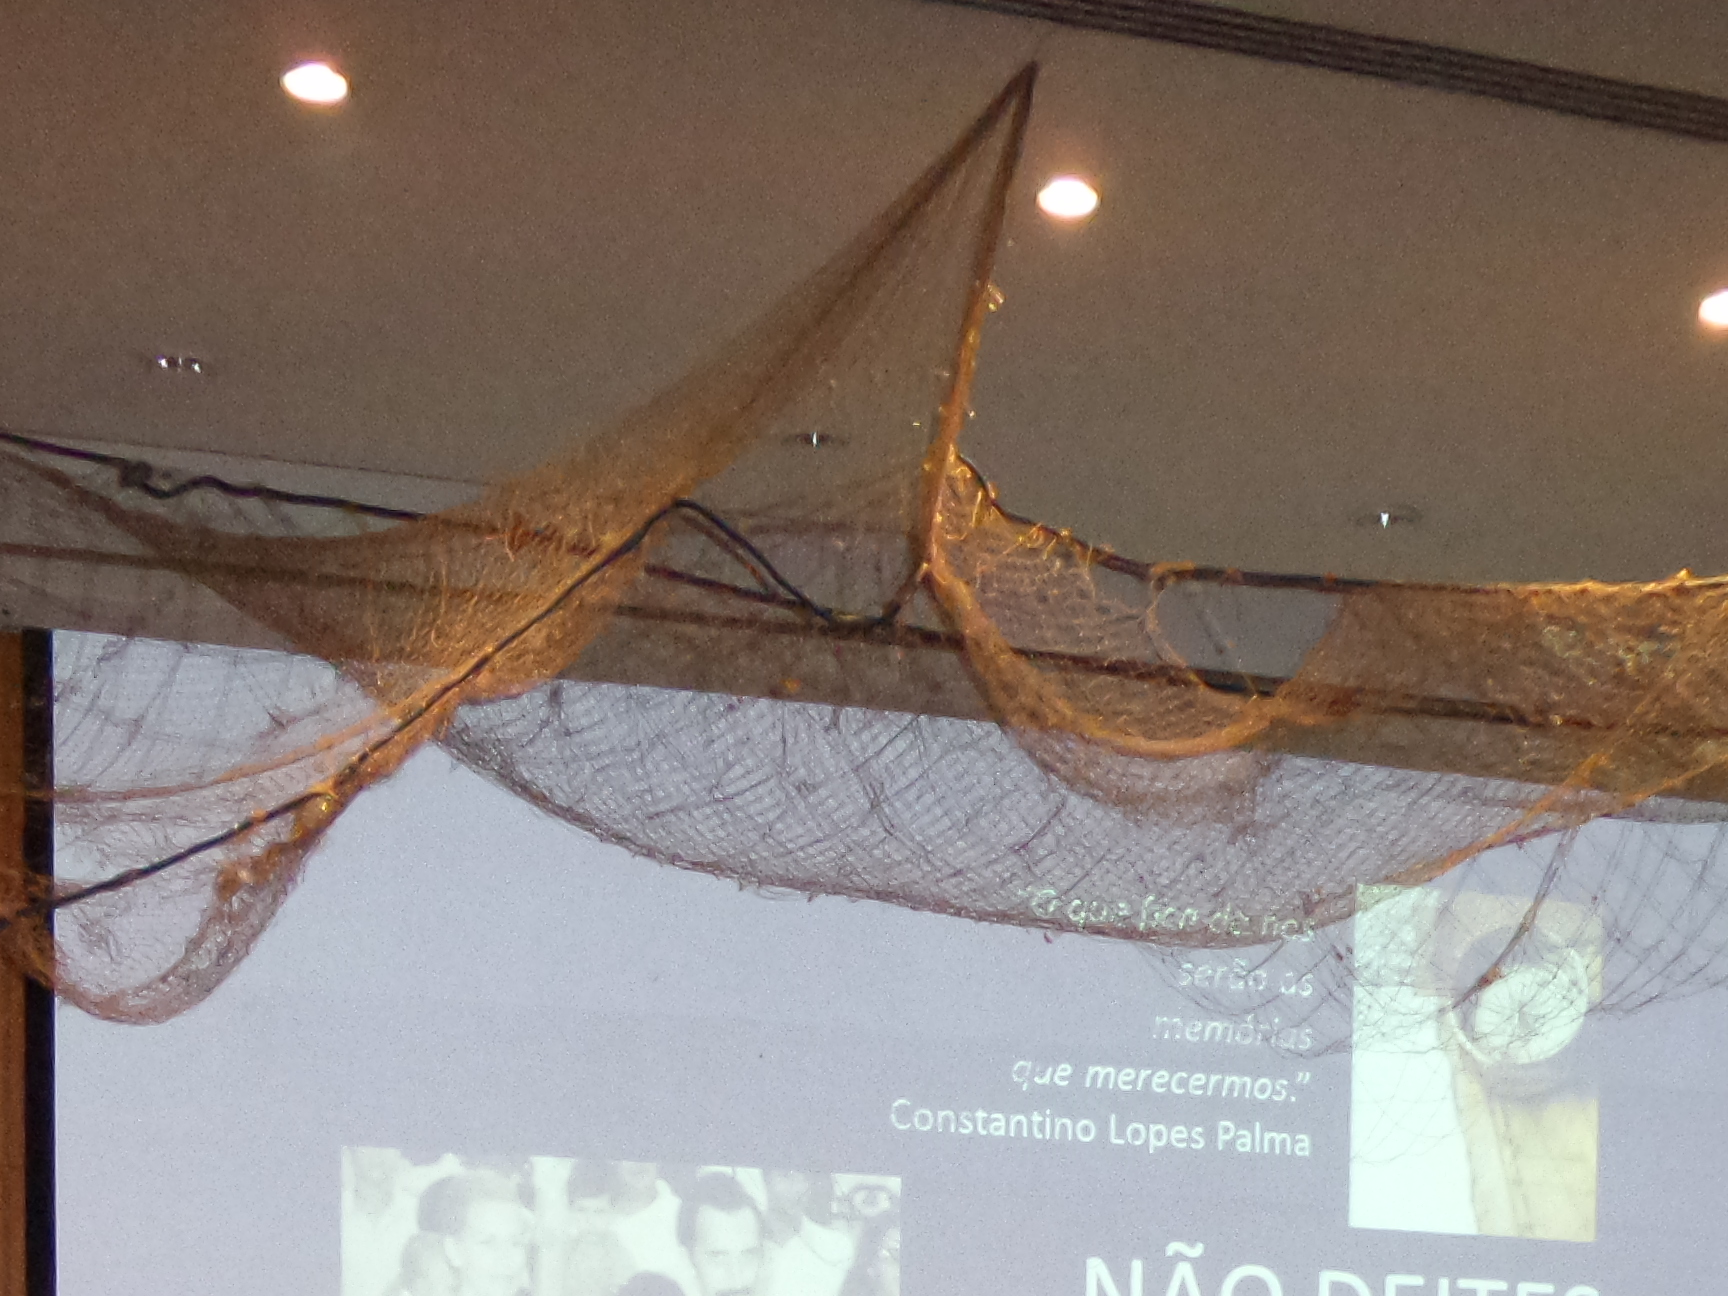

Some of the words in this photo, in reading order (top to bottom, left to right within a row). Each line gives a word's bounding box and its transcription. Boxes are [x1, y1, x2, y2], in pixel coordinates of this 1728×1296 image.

[1152, 1012, 1315, 1052] memórias
[1011, 1058, 1073, 1090] que
[1084, 1062, 1312, 1103] merecermos.”
[888, 1098, 1097, 1143] Constantino
[1108, 1112, 1206, 1155] Lopes
[1216, 1119, 1312, 1157] Palma
